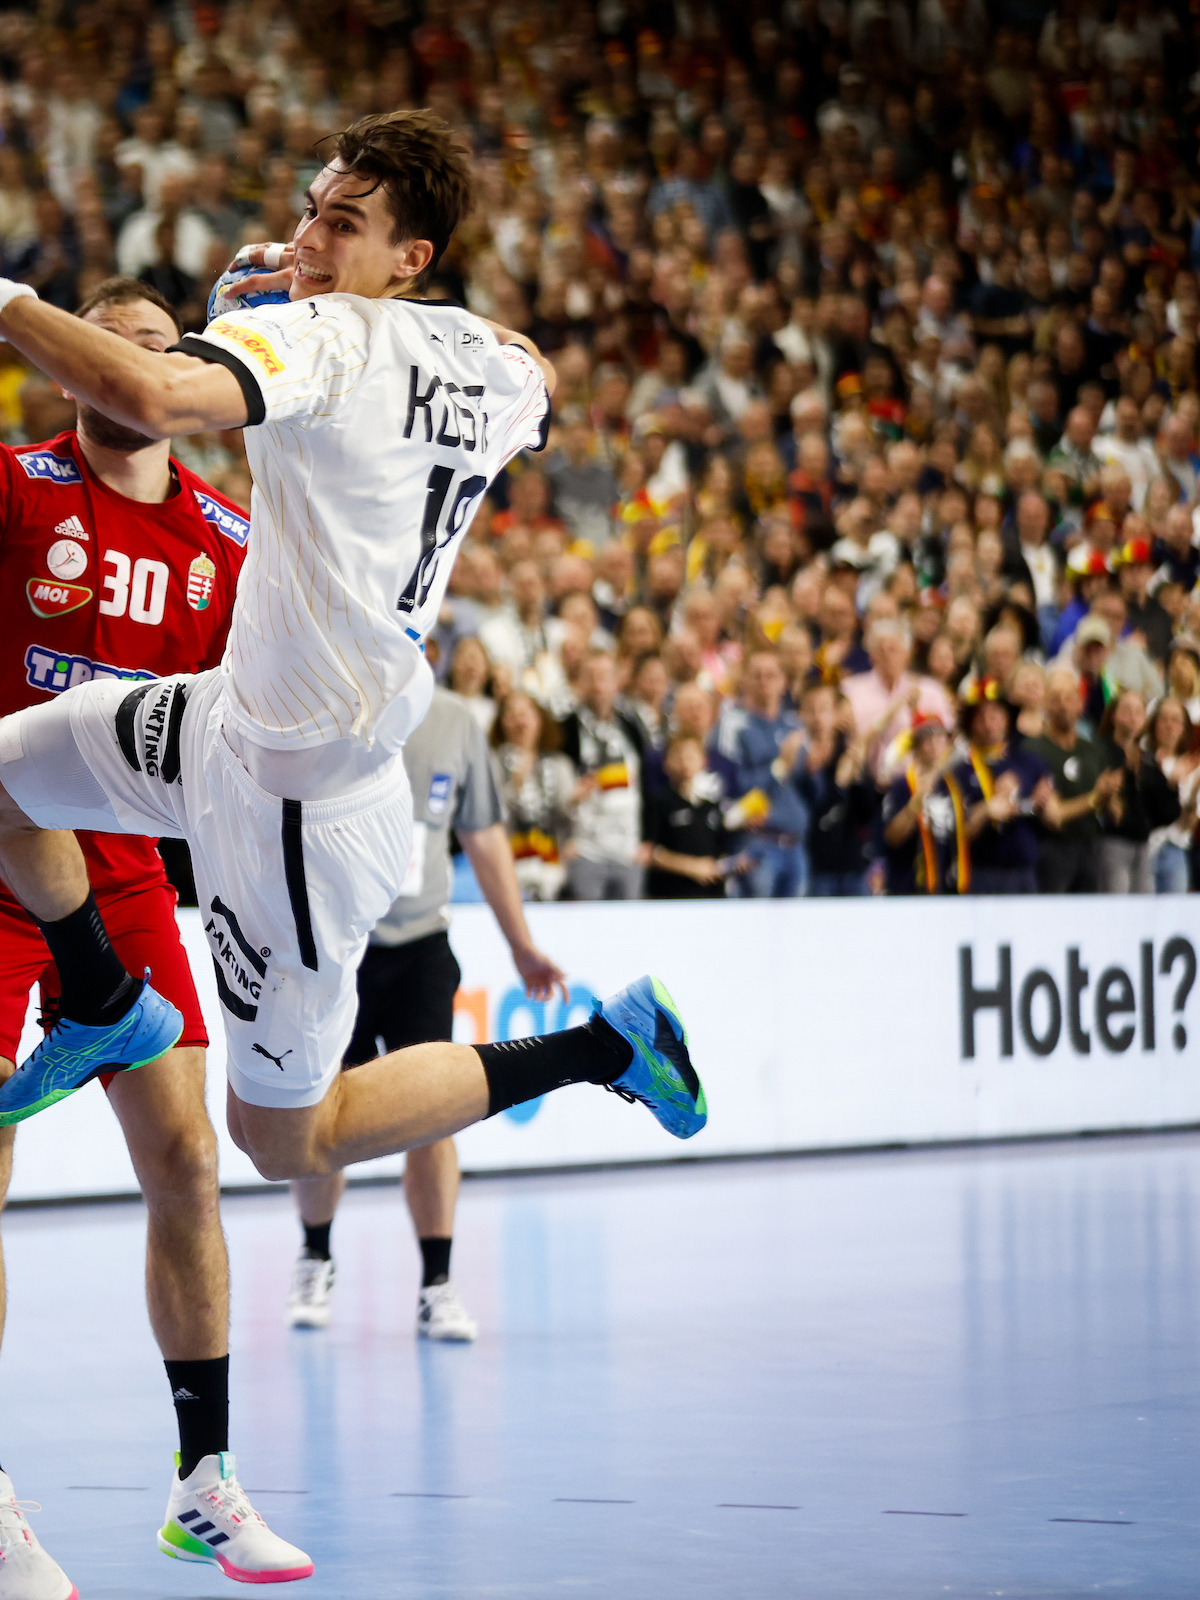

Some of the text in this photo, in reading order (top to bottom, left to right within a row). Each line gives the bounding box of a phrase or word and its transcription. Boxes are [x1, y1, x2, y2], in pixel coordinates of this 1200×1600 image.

[36, 457, 77, 477] JYSK
[54, 525, 90, 541] adidas
[201, 501, 249, 539] JYSK
[33, 584, 70, 604] MOL
[99, 548, 170, 626] 30
[957, 935, 1198, 1060] Hotel?
